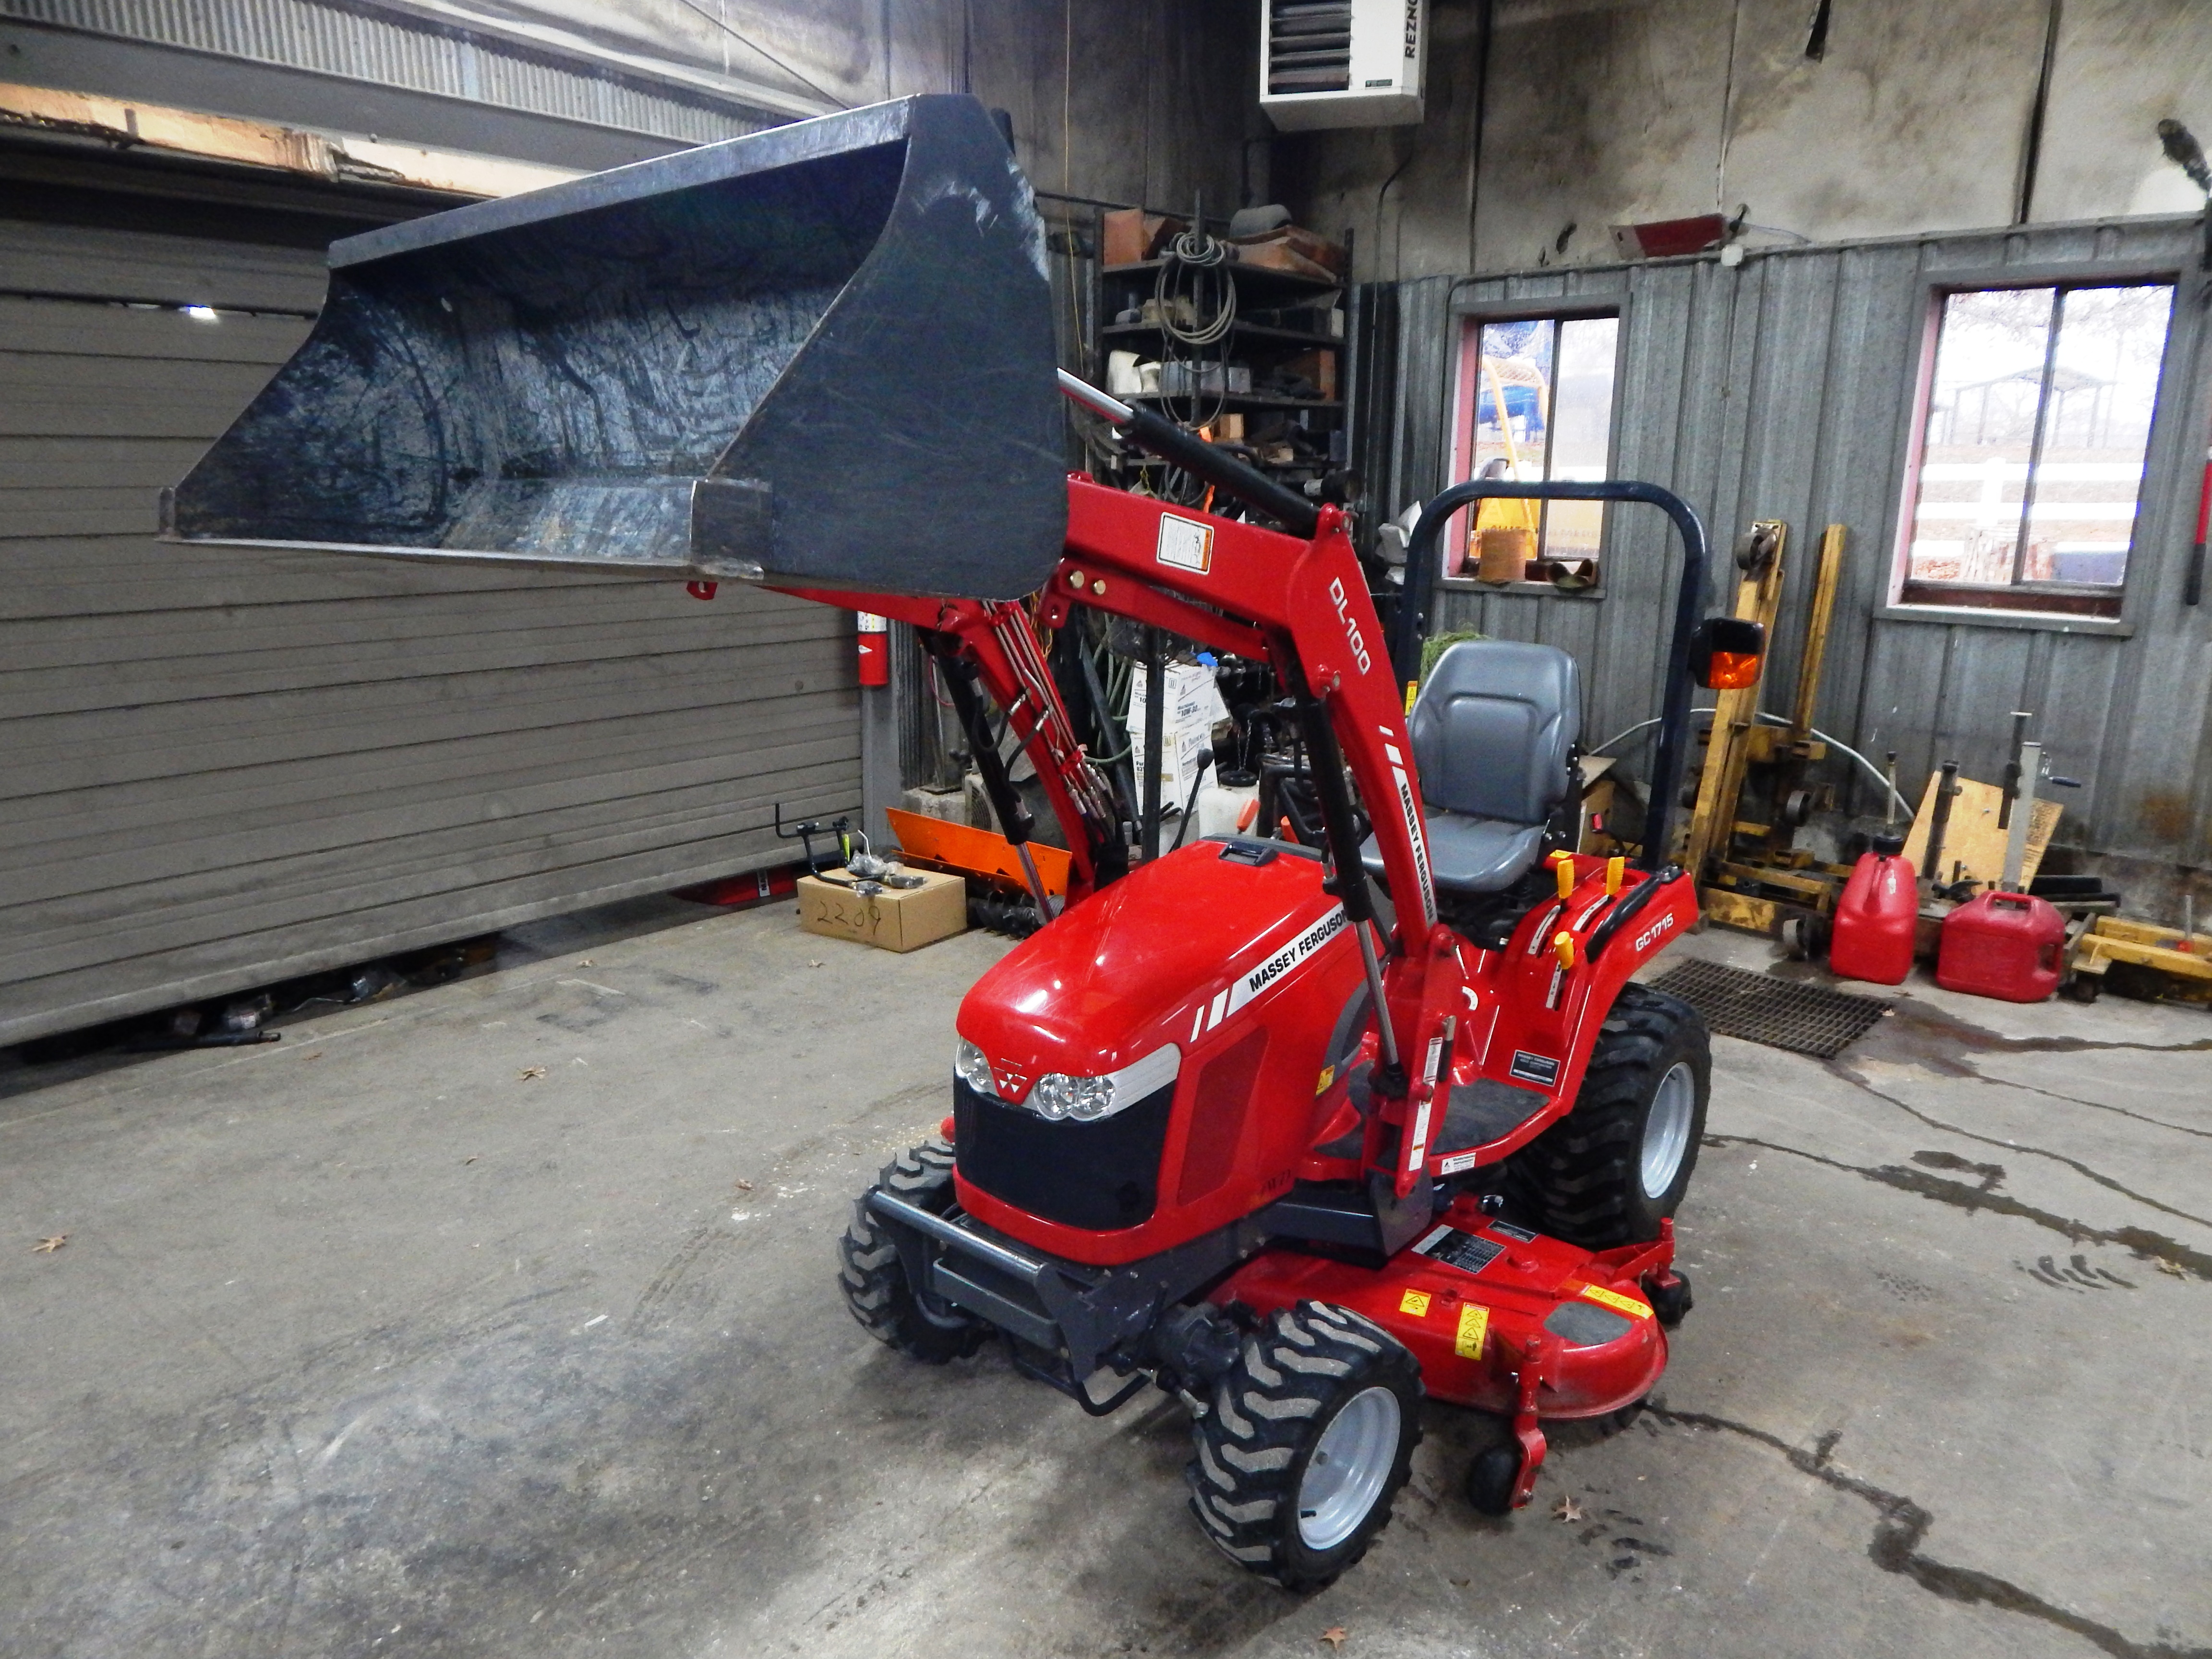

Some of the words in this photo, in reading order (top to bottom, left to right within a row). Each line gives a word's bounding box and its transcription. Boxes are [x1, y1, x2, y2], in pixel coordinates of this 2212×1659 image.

[1329, 577, 1371, 675] DL100
[1401, 783, 1419, 842] MASSEY
[1415, 844, 1433, 919] FERGUSON
[817, 901, 881, 936] 2209
[1249, 947, 1296, 992] MASSEY
